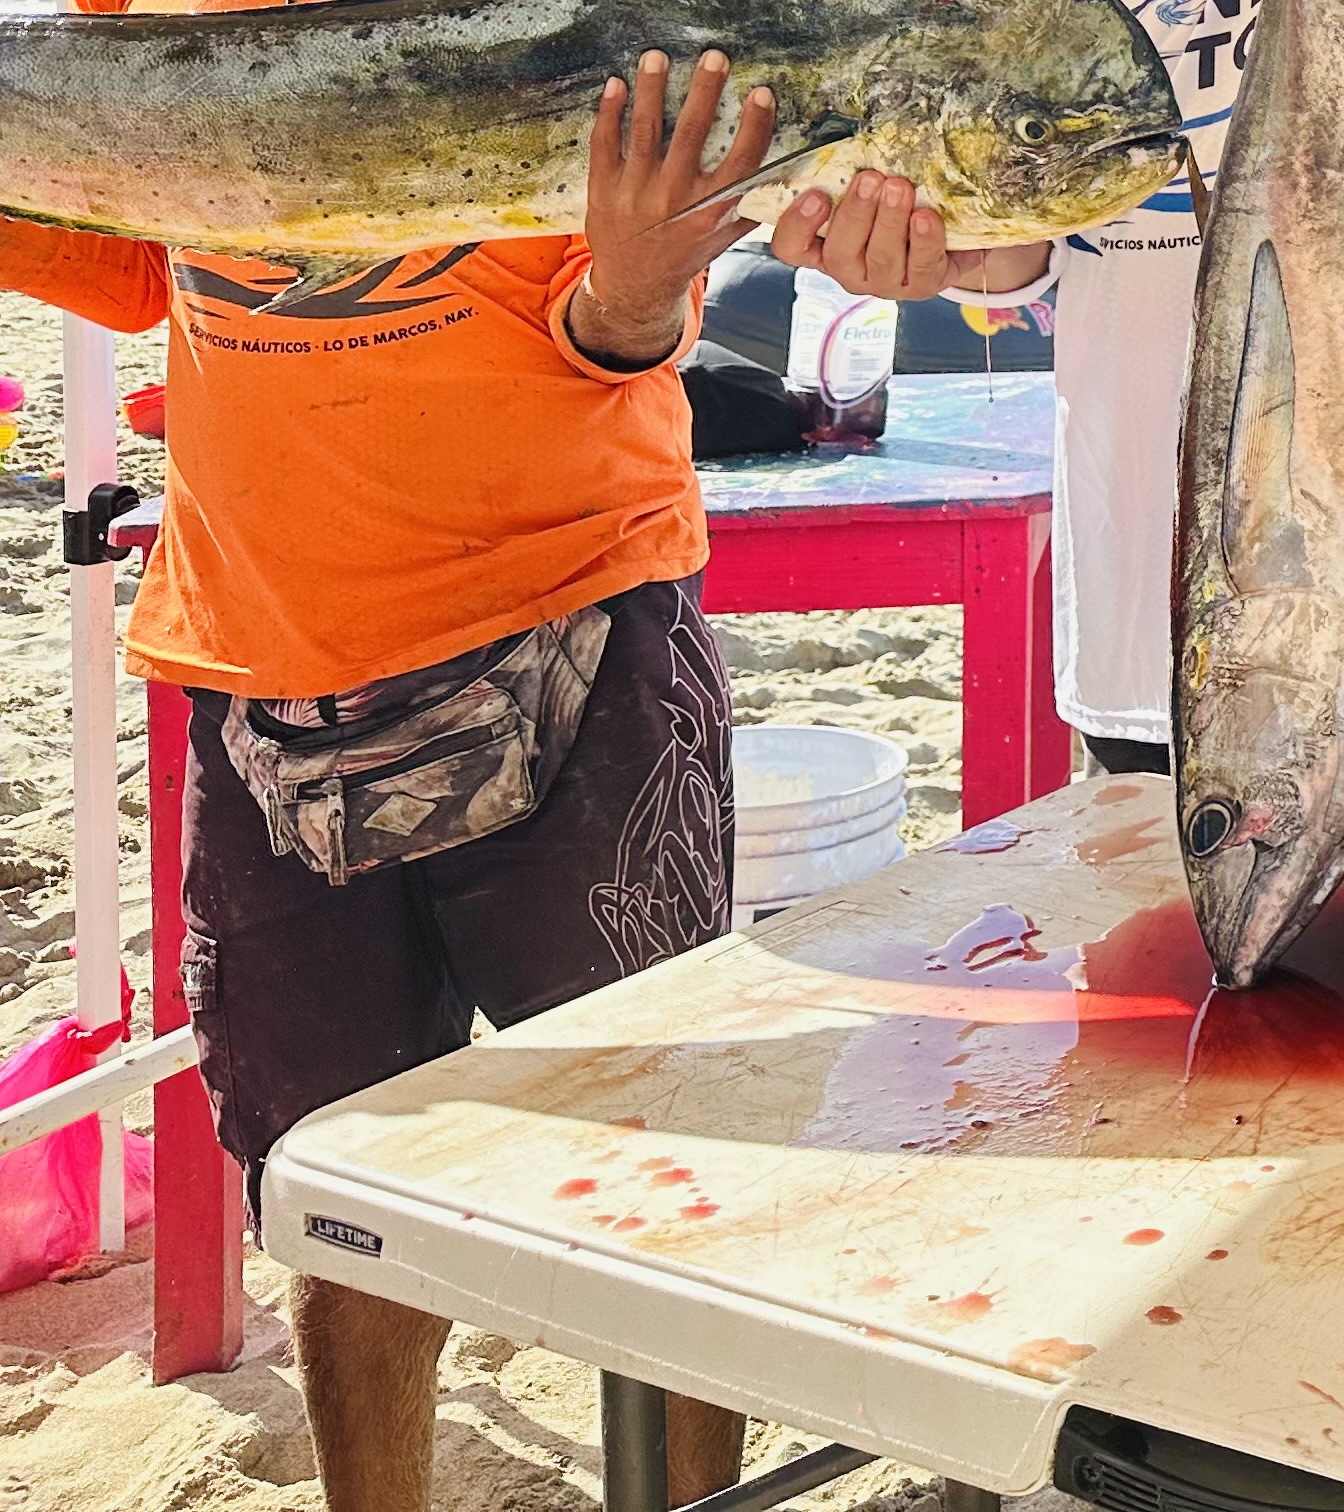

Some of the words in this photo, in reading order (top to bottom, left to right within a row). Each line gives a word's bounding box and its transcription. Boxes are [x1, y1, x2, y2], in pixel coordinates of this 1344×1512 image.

[189, 322, 239, 351] SERVICIOS
[240, 337, 312, 354] NÁUTICOS
[323, 339, 344, 352] LO
[347, 335, 369, 349] DE
[372, 319, 444, 346] MARCOS,
[444, 306, 480, 326] NAY.
[315, 1217, 377, 1250] LIFETIME
